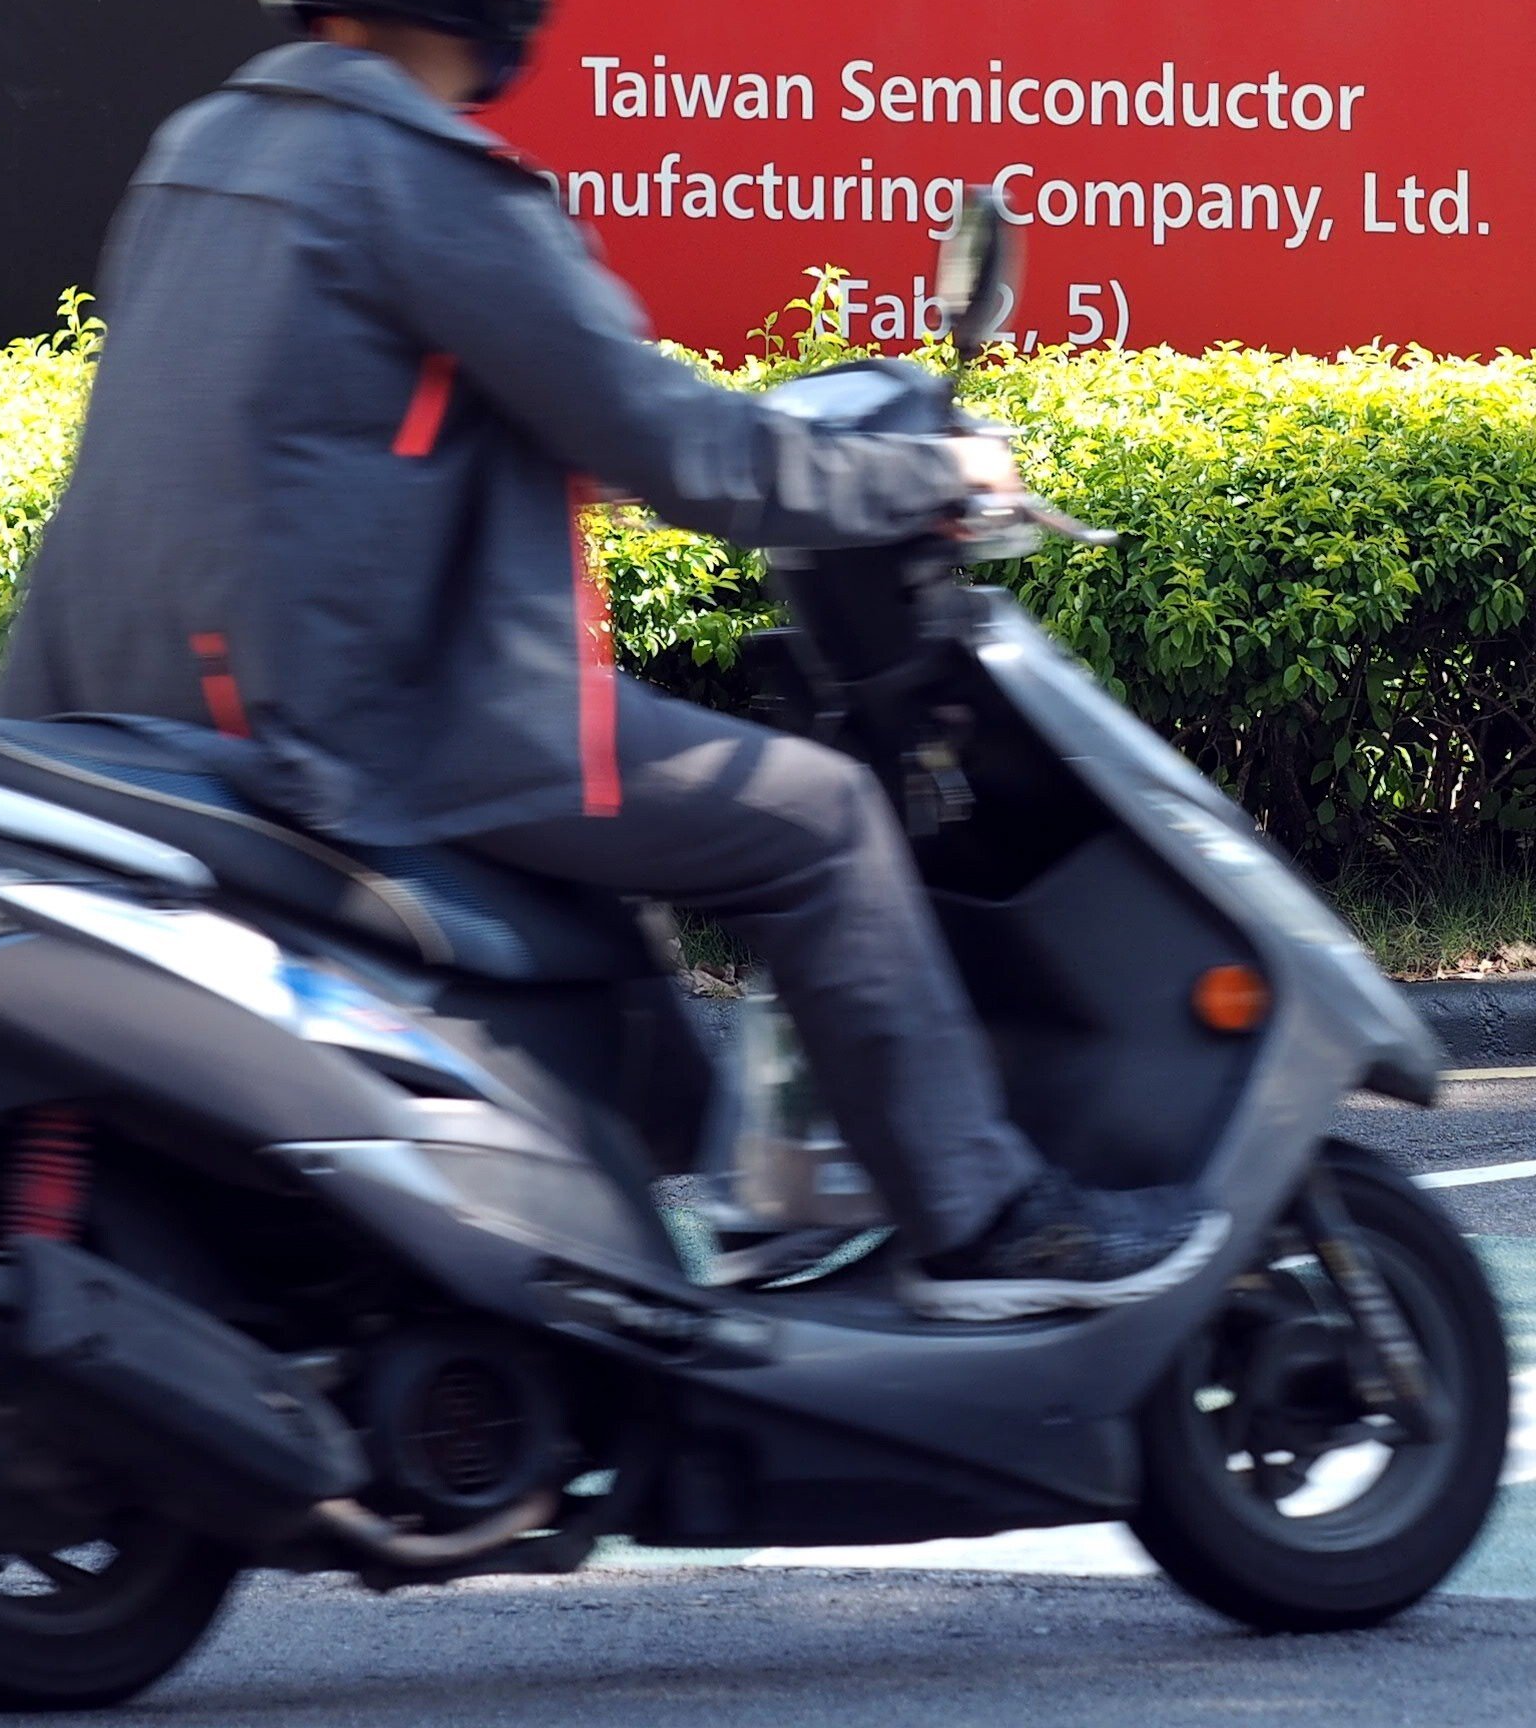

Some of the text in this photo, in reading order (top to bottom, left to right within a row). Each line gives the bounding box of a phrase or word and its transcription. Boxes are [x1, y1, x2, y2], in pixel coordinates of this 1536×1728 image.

[581, 54, 1366, 132] Taiwan Semiconductor
[526, 153, 1491, 249] nufacturing Company, Ltd.
[1067, 279, 1131, 351] 5)
